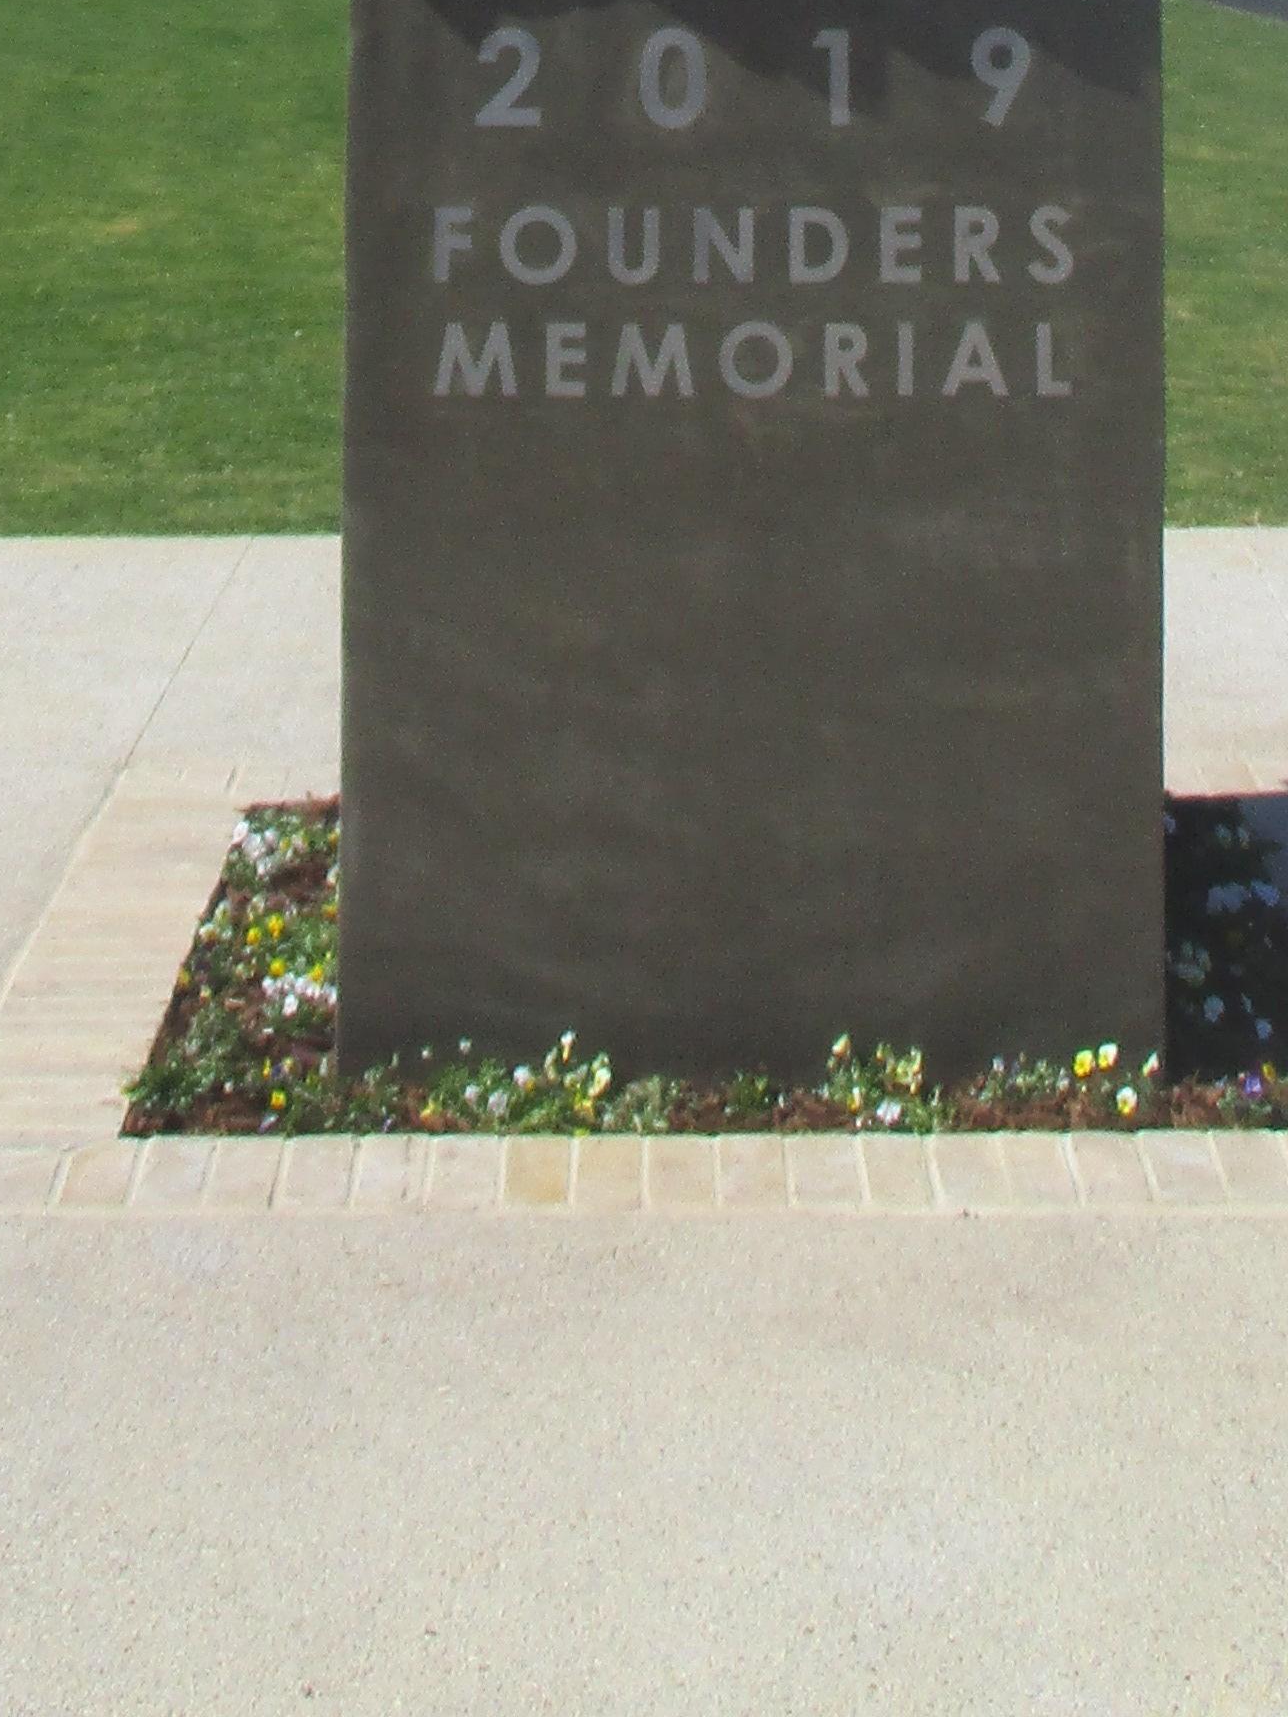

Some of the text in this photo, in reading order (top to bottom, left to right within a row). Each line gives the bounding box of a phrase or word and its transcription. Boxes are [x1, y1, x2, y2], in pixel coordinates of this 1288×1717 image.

[474, 26, 1032, 129] 2019
[432, 205, 1075, 286] FOUNDERS
[432, 321, 1073, 398] MEMORIAL
